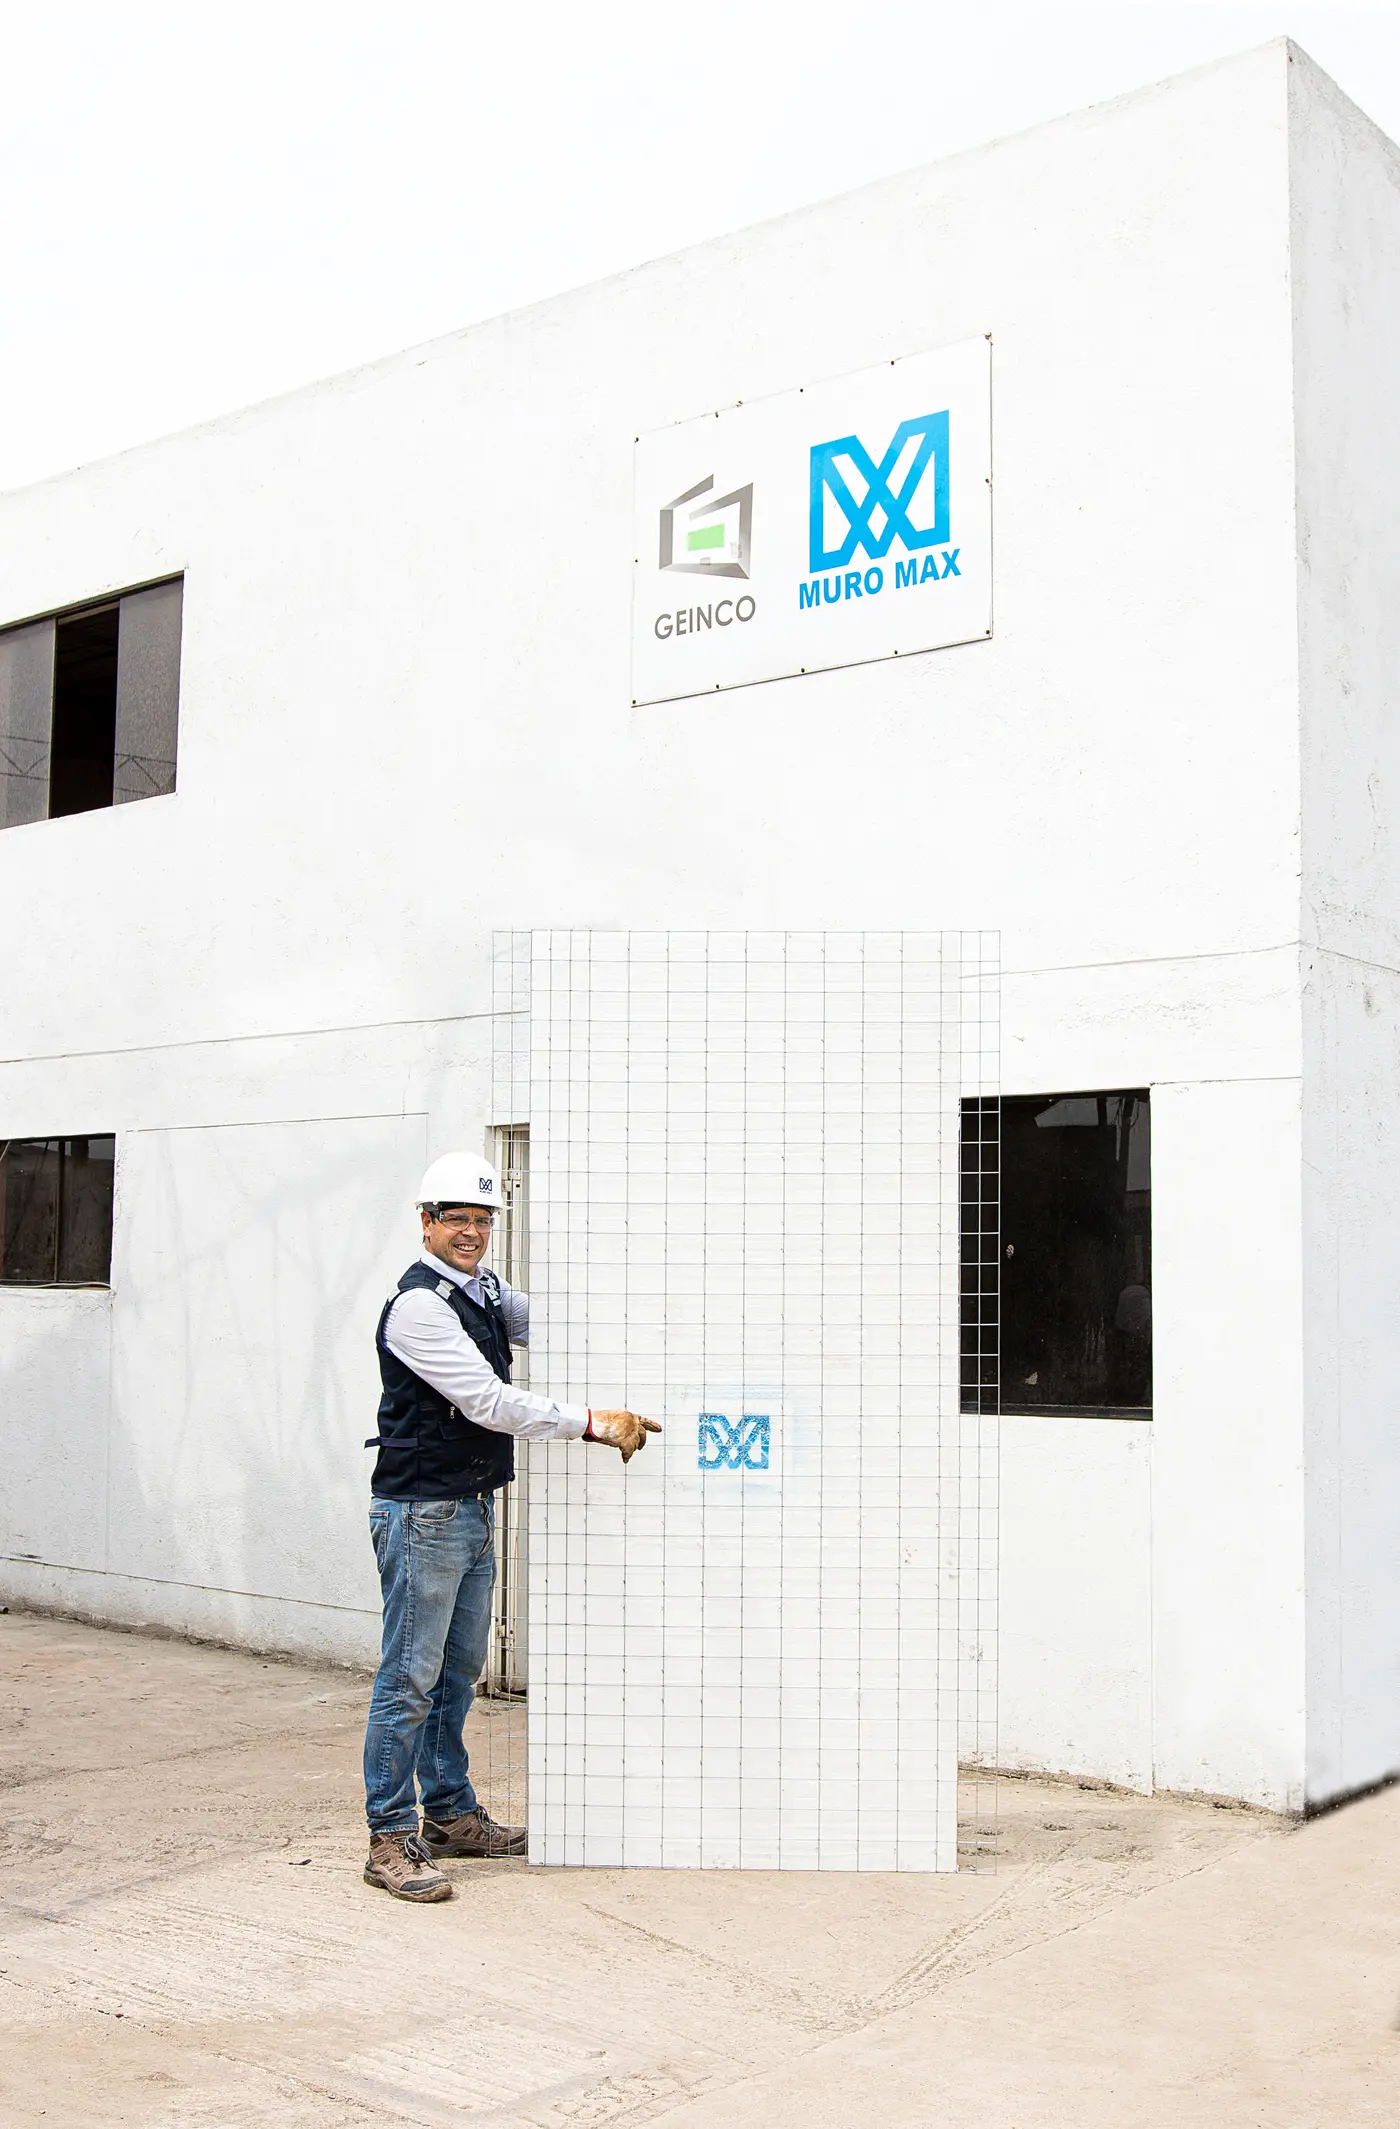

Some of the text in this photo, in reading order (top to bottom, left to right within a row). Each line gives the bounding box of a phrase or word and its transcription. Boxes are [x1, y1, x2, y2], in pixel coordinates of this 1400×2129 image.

[799, 548, 961, 610] MURO MAX
[654, 595, 756, 640] GEINCO
